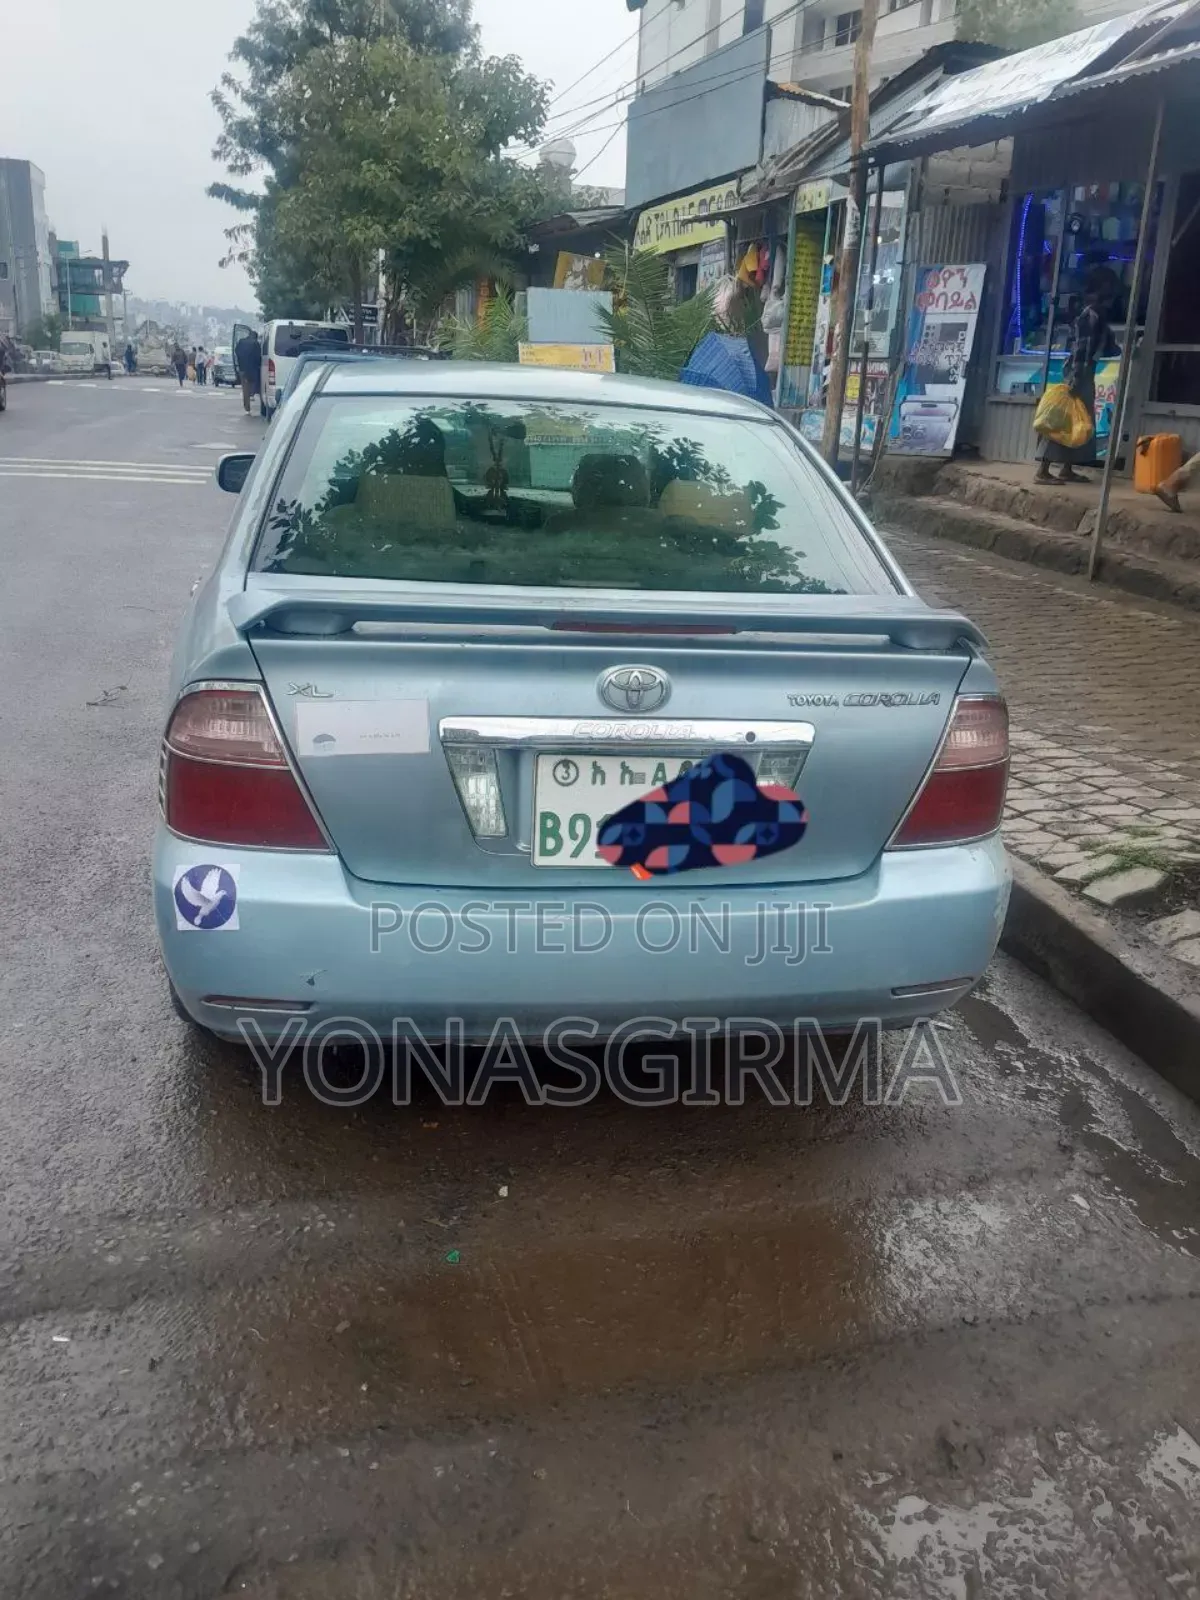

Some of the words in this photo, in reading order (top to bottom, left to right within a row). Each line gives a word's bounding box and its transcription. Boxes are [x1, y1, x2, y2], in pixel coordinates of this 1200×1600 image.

[787, 693, 839, 707] TOYOTA
[842, 692, 941, 708] COROLLA
[573, 722, 698, 740] COROLLA
[539, 811, 613, 859] B9
